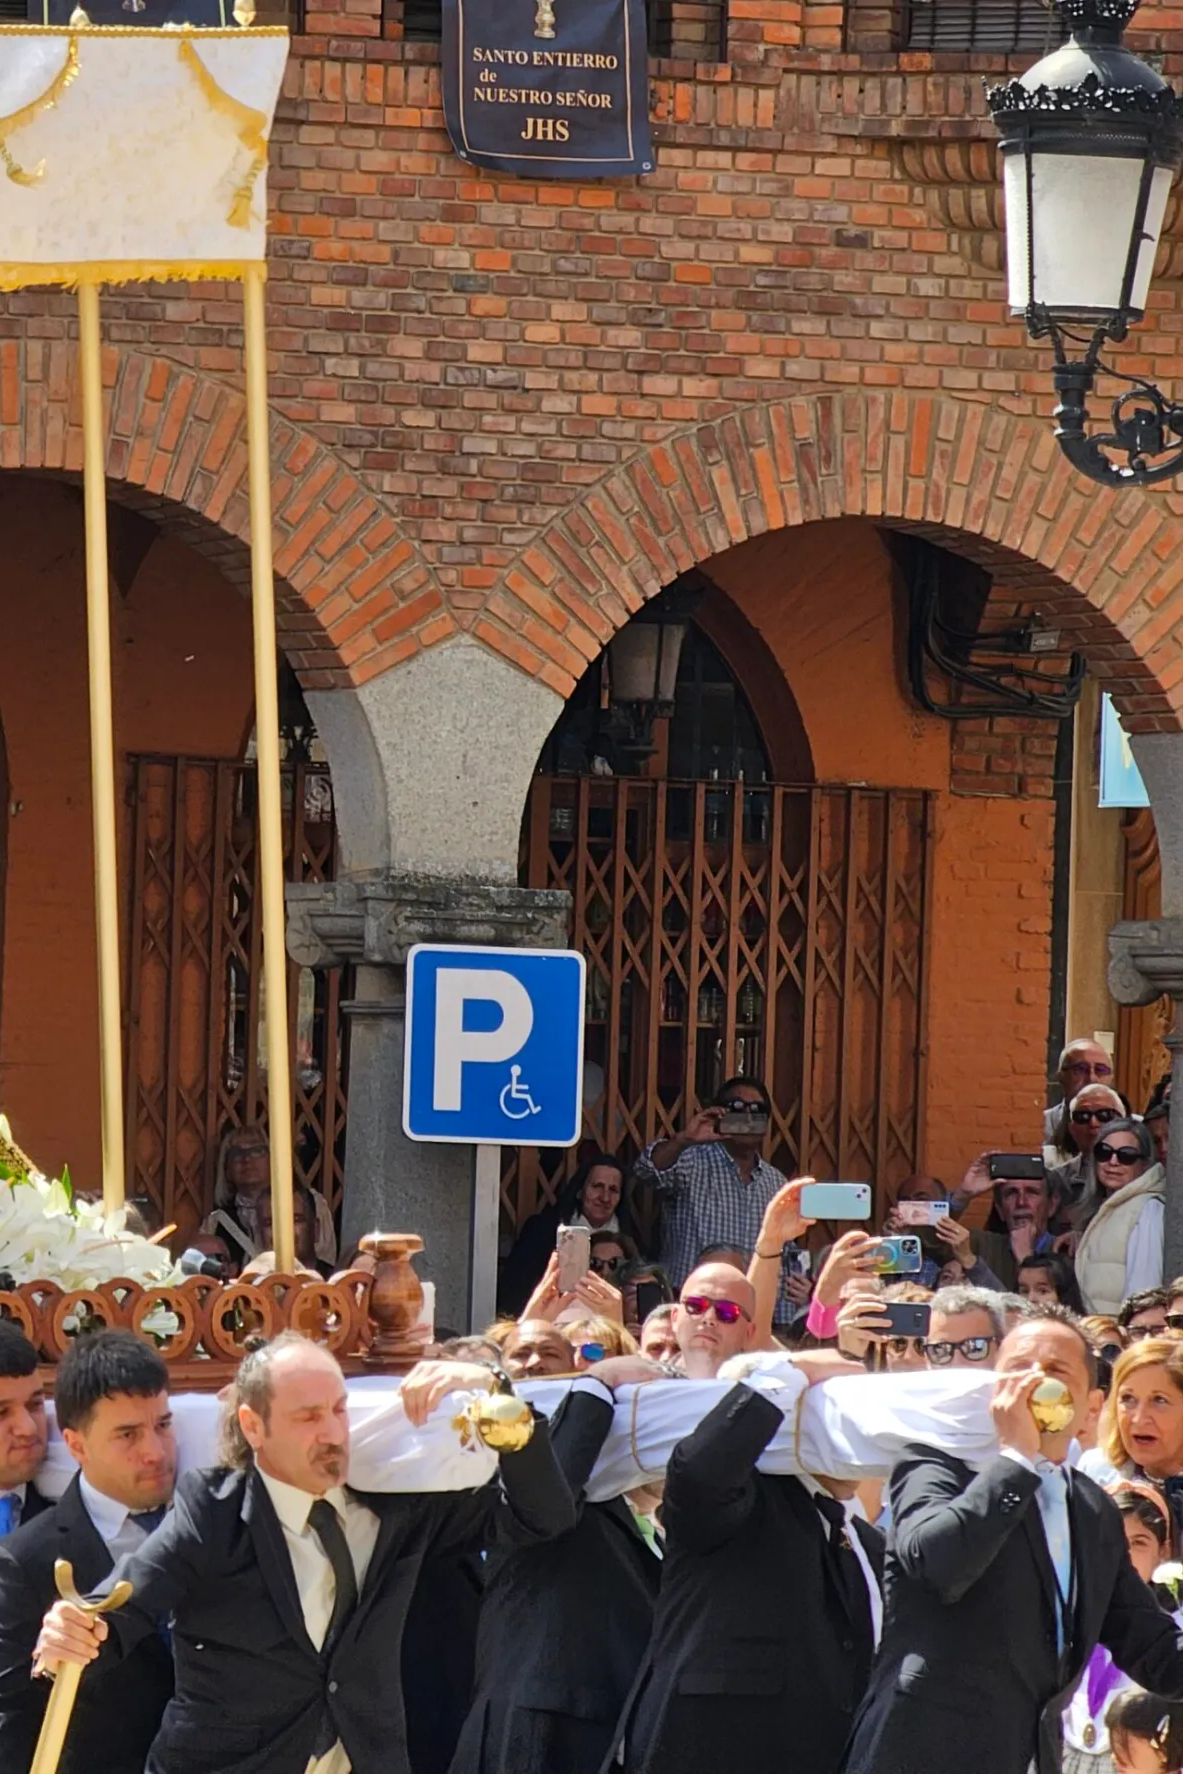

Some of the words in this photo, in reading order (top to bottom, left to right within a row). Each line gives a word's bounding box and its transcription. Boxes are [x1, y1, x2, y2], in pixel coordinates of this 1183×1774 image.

[473, 47, 529, 66] SANTO
[533, 51, 618, 70] ENTIERRO
[479, 68, 497, 83] de
[473, 87, 553, 106] NUESTRO
[556, 90, 613, 109] SEÑOR
[521, 118, 570, 142] JHS
[433, 967, 534, 1111] P
